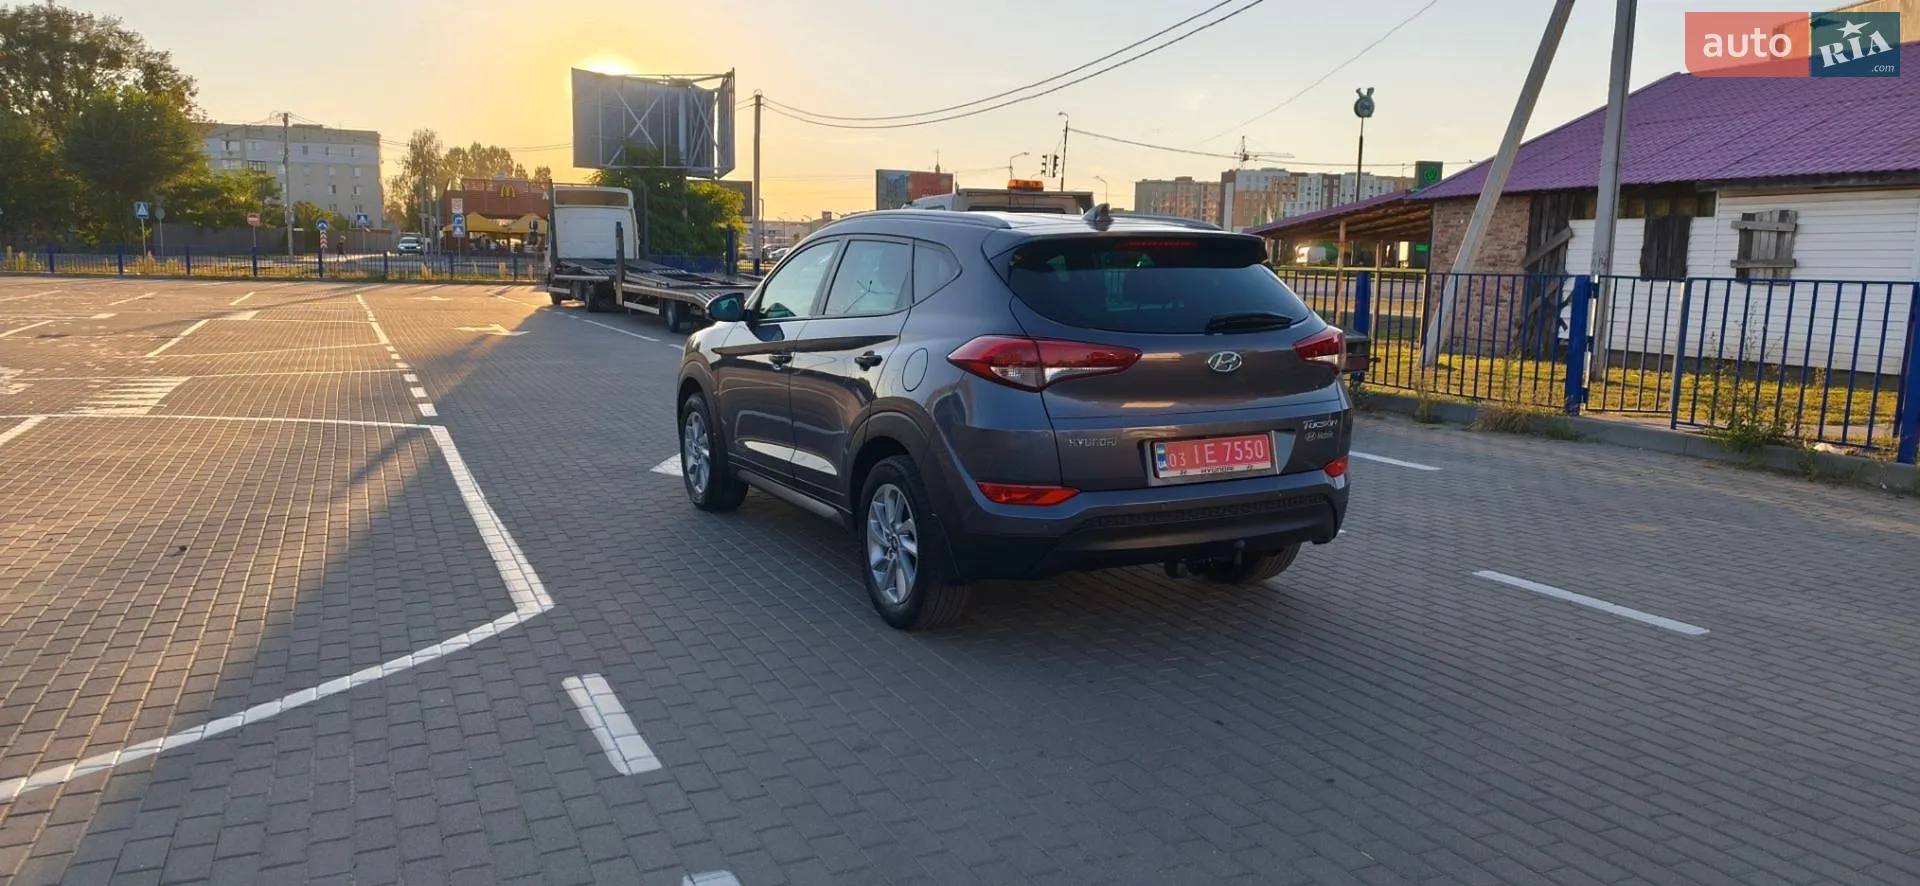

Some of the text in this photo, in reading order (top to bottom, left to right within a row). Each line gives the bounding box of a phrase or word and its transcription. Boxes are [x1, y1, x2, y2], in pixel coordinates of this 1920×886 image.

[1069, 437, 1117, 448] HYUNDAI
[1168, 439, 1264, 468] 03 IE 7550
